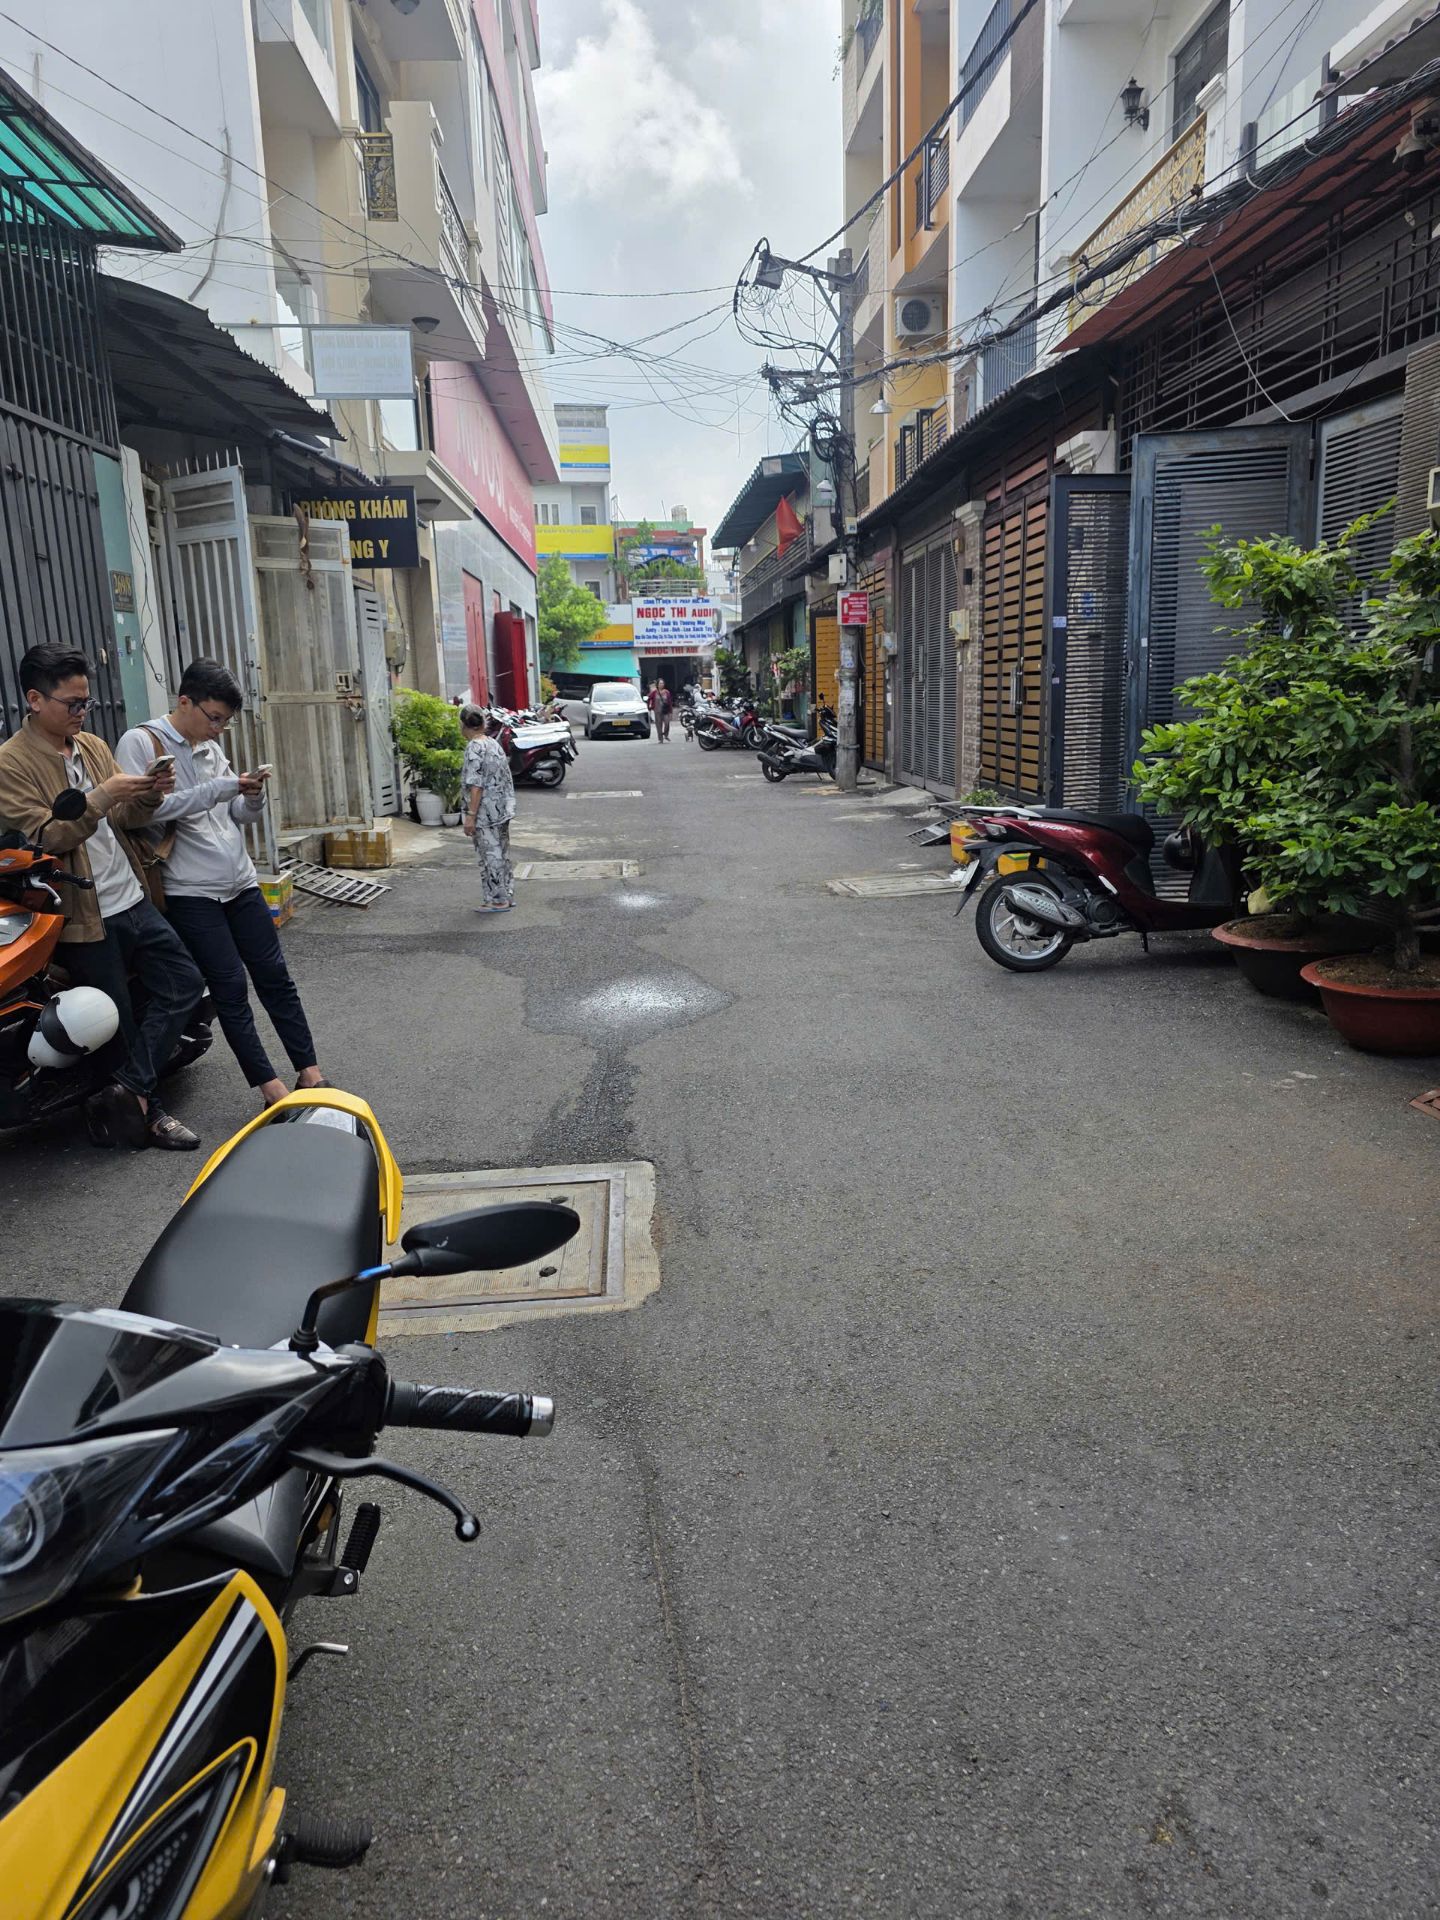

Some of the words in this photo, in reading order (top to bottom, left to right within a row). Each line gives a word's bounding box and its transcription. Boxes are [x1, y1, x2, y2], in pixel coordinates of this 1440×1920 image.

[301, 496, 356, 519] PHÒNG
[360, 496, 408, 518] KHÁM
[350, 540, 374, 558] NG
[379, 540, 389, 558] Y
[636, 607, 665, 620] NGỌC
[670, 607, 687, 618] THI
